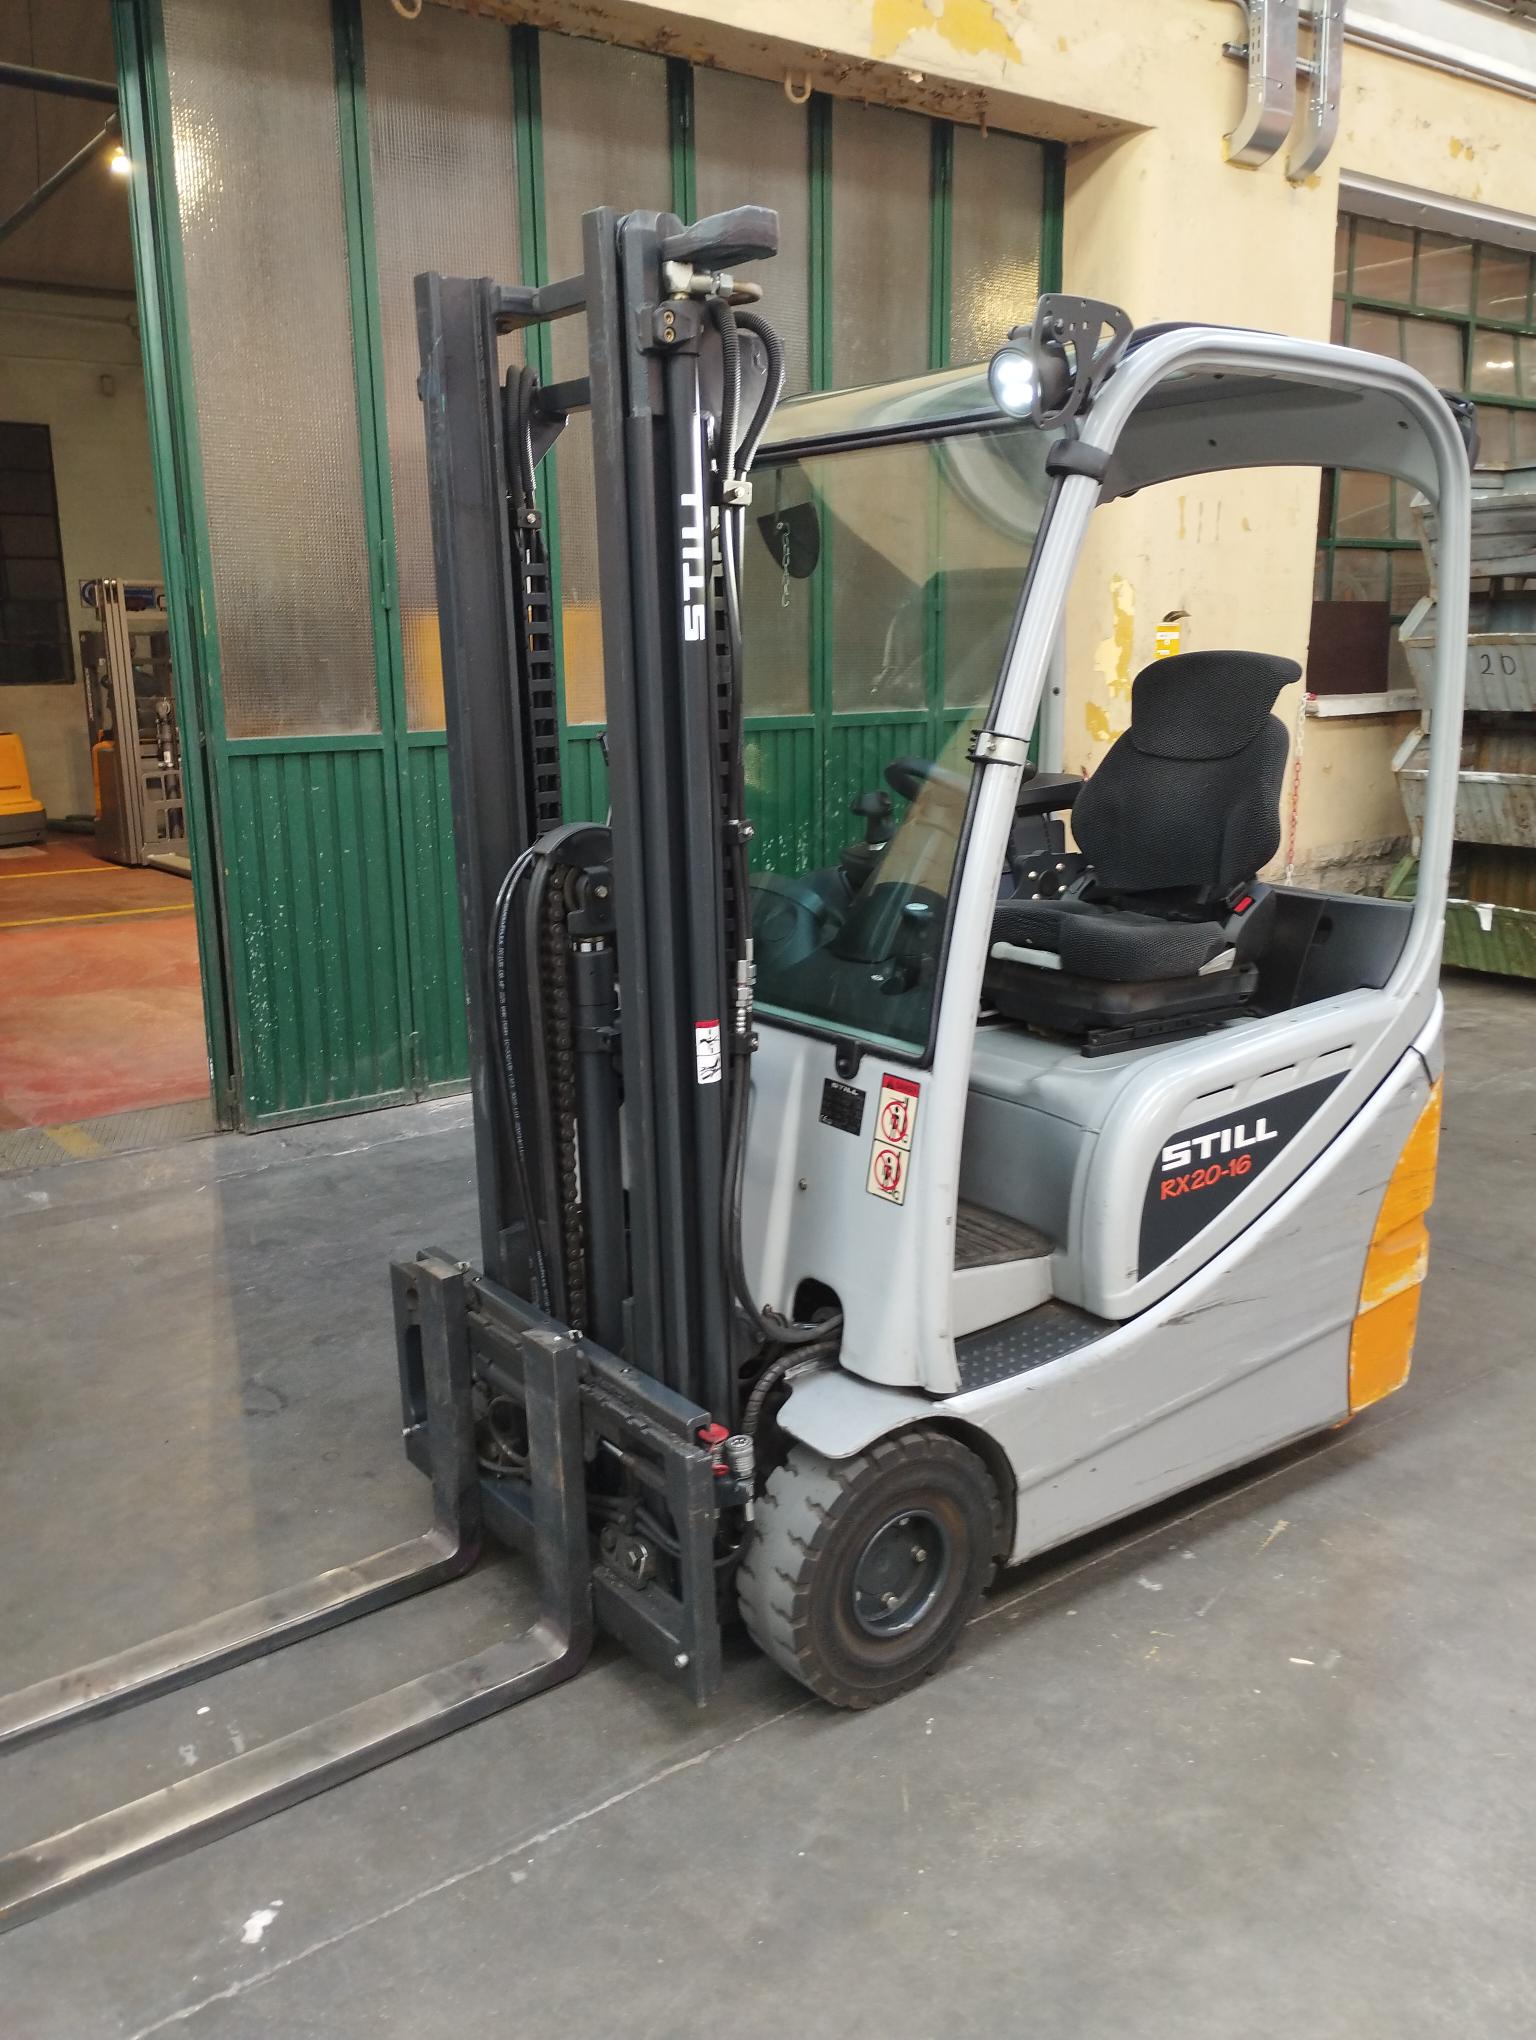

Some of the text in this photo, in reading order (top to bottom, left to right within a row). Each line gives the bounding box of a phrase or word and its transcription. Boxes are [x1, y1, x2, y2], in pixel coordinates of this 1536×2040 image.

[681, 493, 706, 641] STILL
[1161, 1117, 1278, 1171] STILL
[1160, 1154, 1251, 1200] RX20-16
